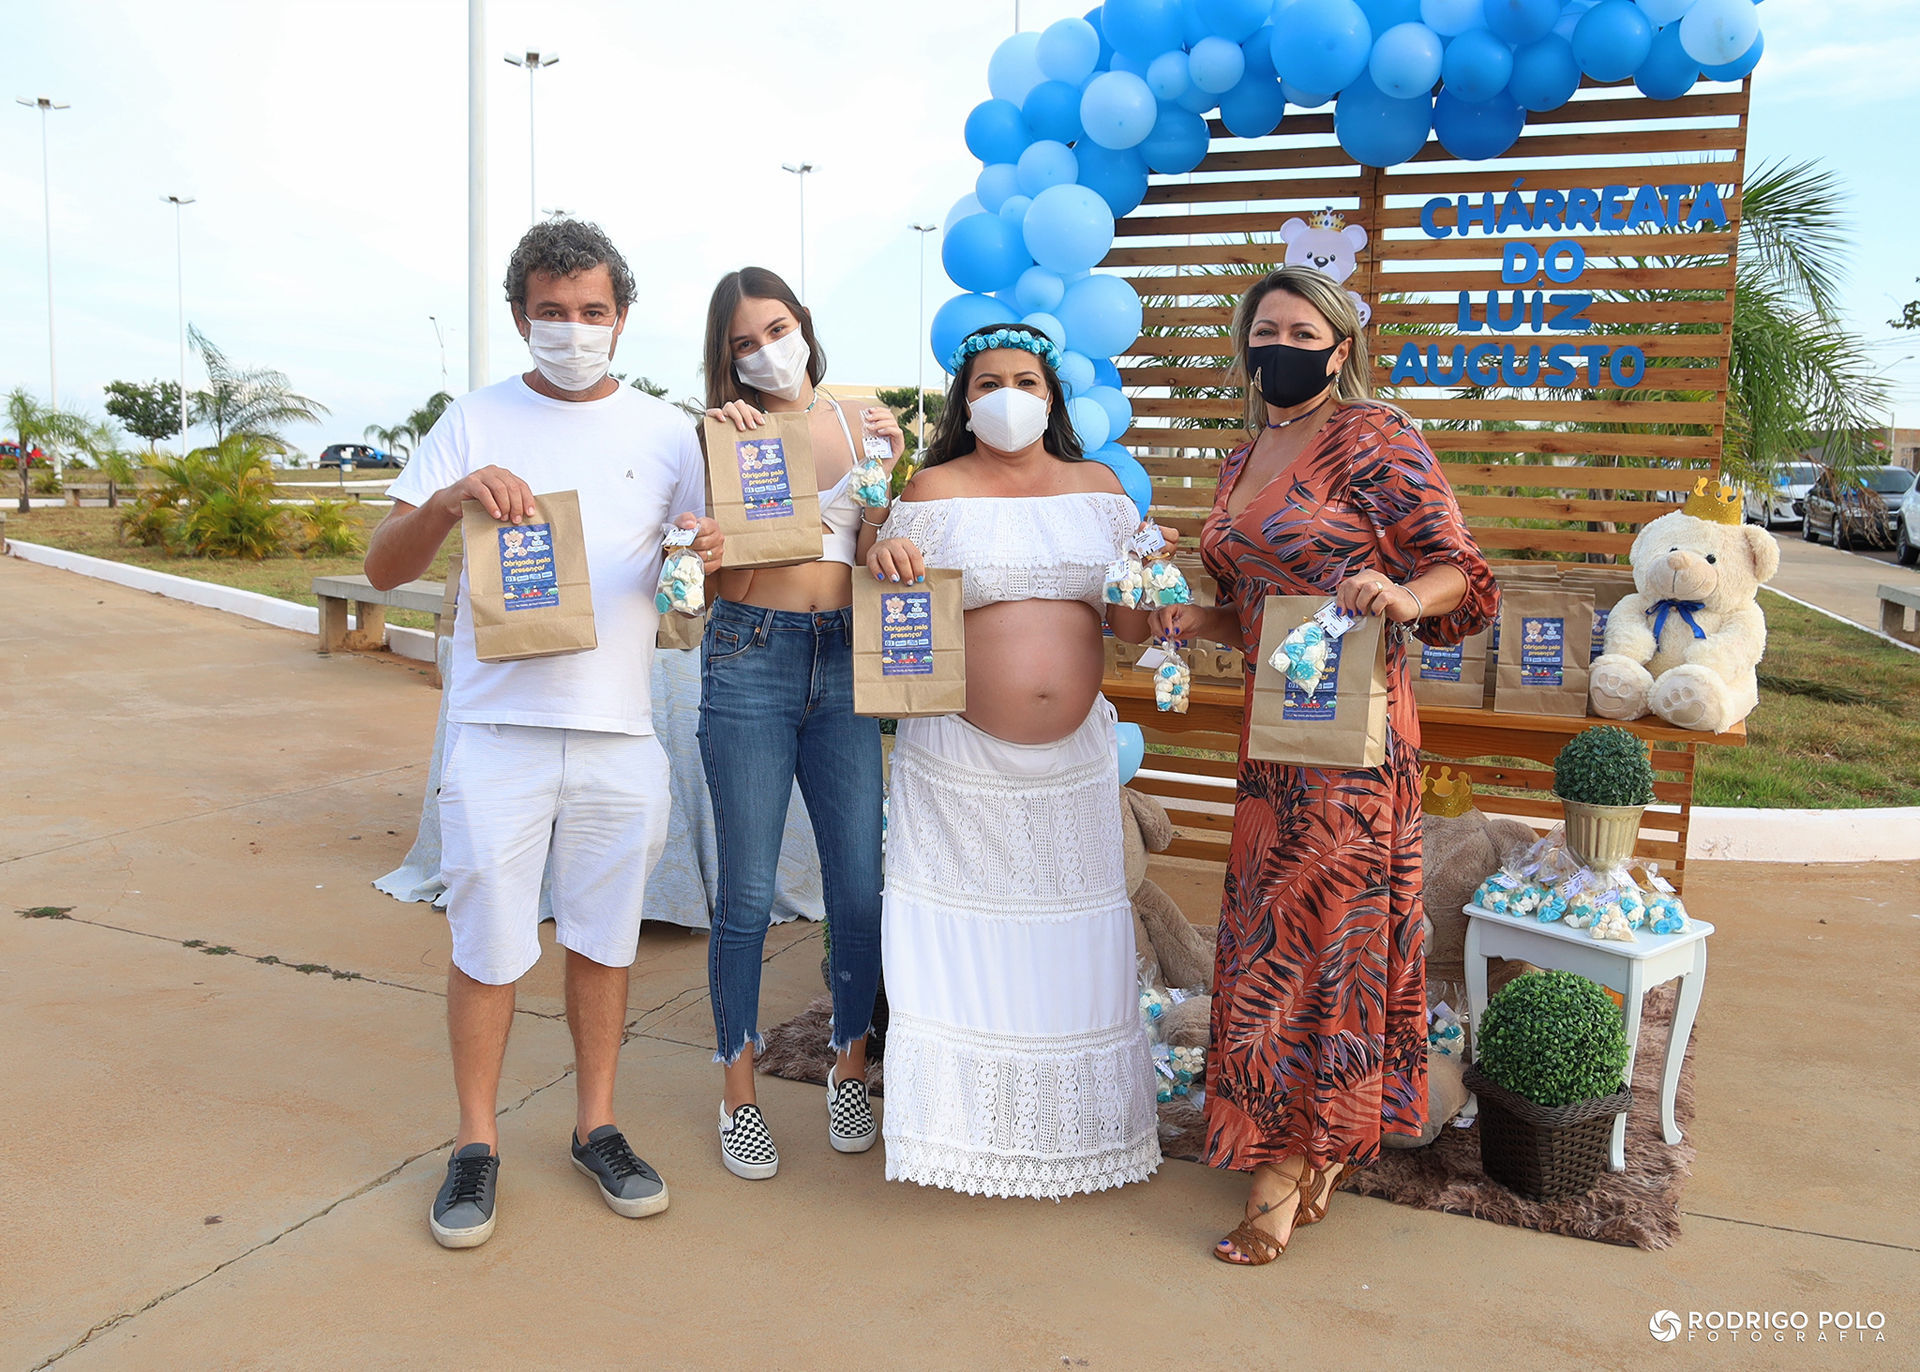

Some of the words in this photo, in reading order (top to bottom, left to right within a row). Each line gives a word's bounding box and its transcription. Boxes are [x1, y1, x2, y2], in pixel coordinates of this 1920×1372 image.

[1420, 177, 1727, 239] CHÁRREATA
[1501, 239, 1585, 284] DO
[1390, 342, 1645, 388] AUGUSTO
